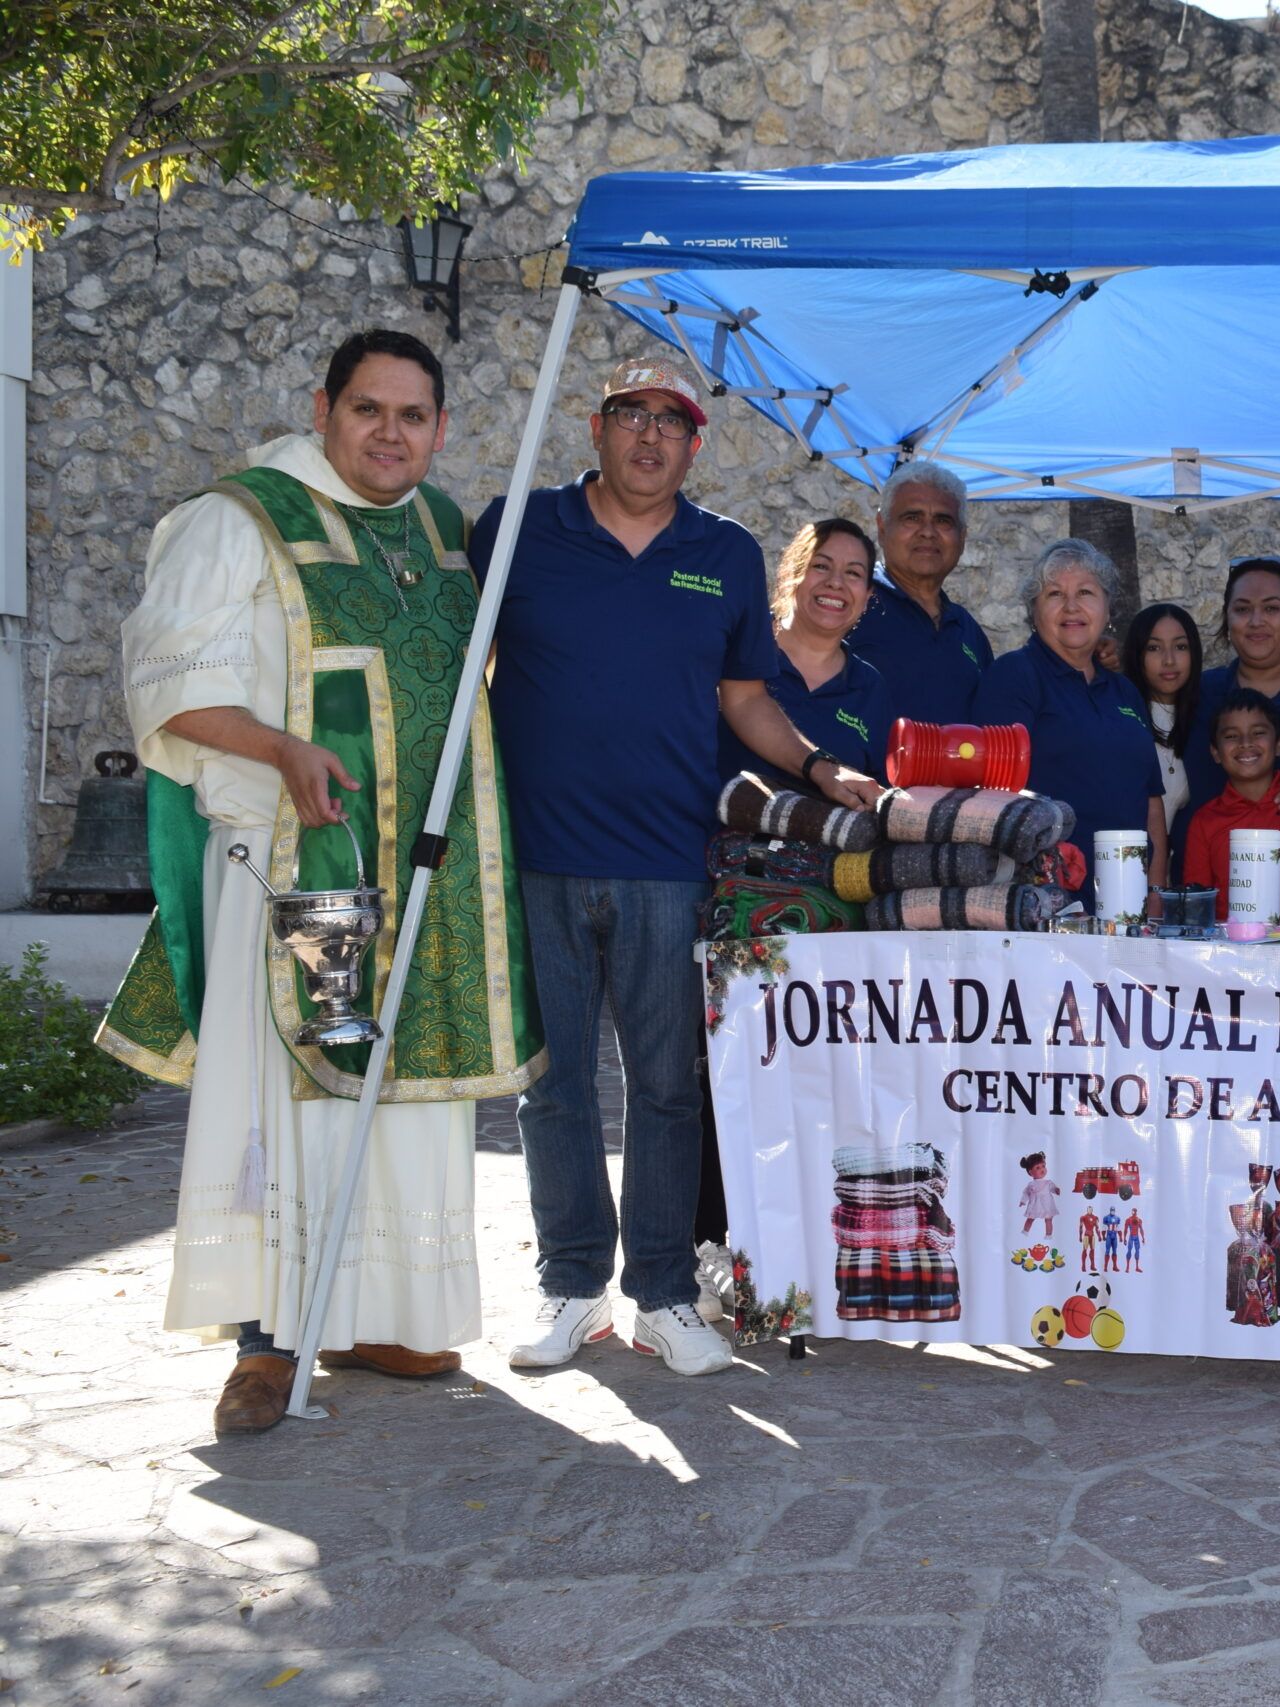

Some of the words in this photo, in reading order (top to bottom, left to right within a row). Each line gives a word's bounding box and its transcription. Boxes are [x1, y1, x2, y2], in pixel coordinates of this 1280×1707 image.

[673, 570, 700, 582] Pastoral
[702, 576, 722, 588] Social
[1239, 852, 1266, 862] ANUAL
[758, 977, 1032, 1067] JORNADA
[1045, 979, 1257, 1052] ANUAL
[942, 1068, 1149, 1119] CENTRO
[1164, 1075, 1235, 1121] DE
